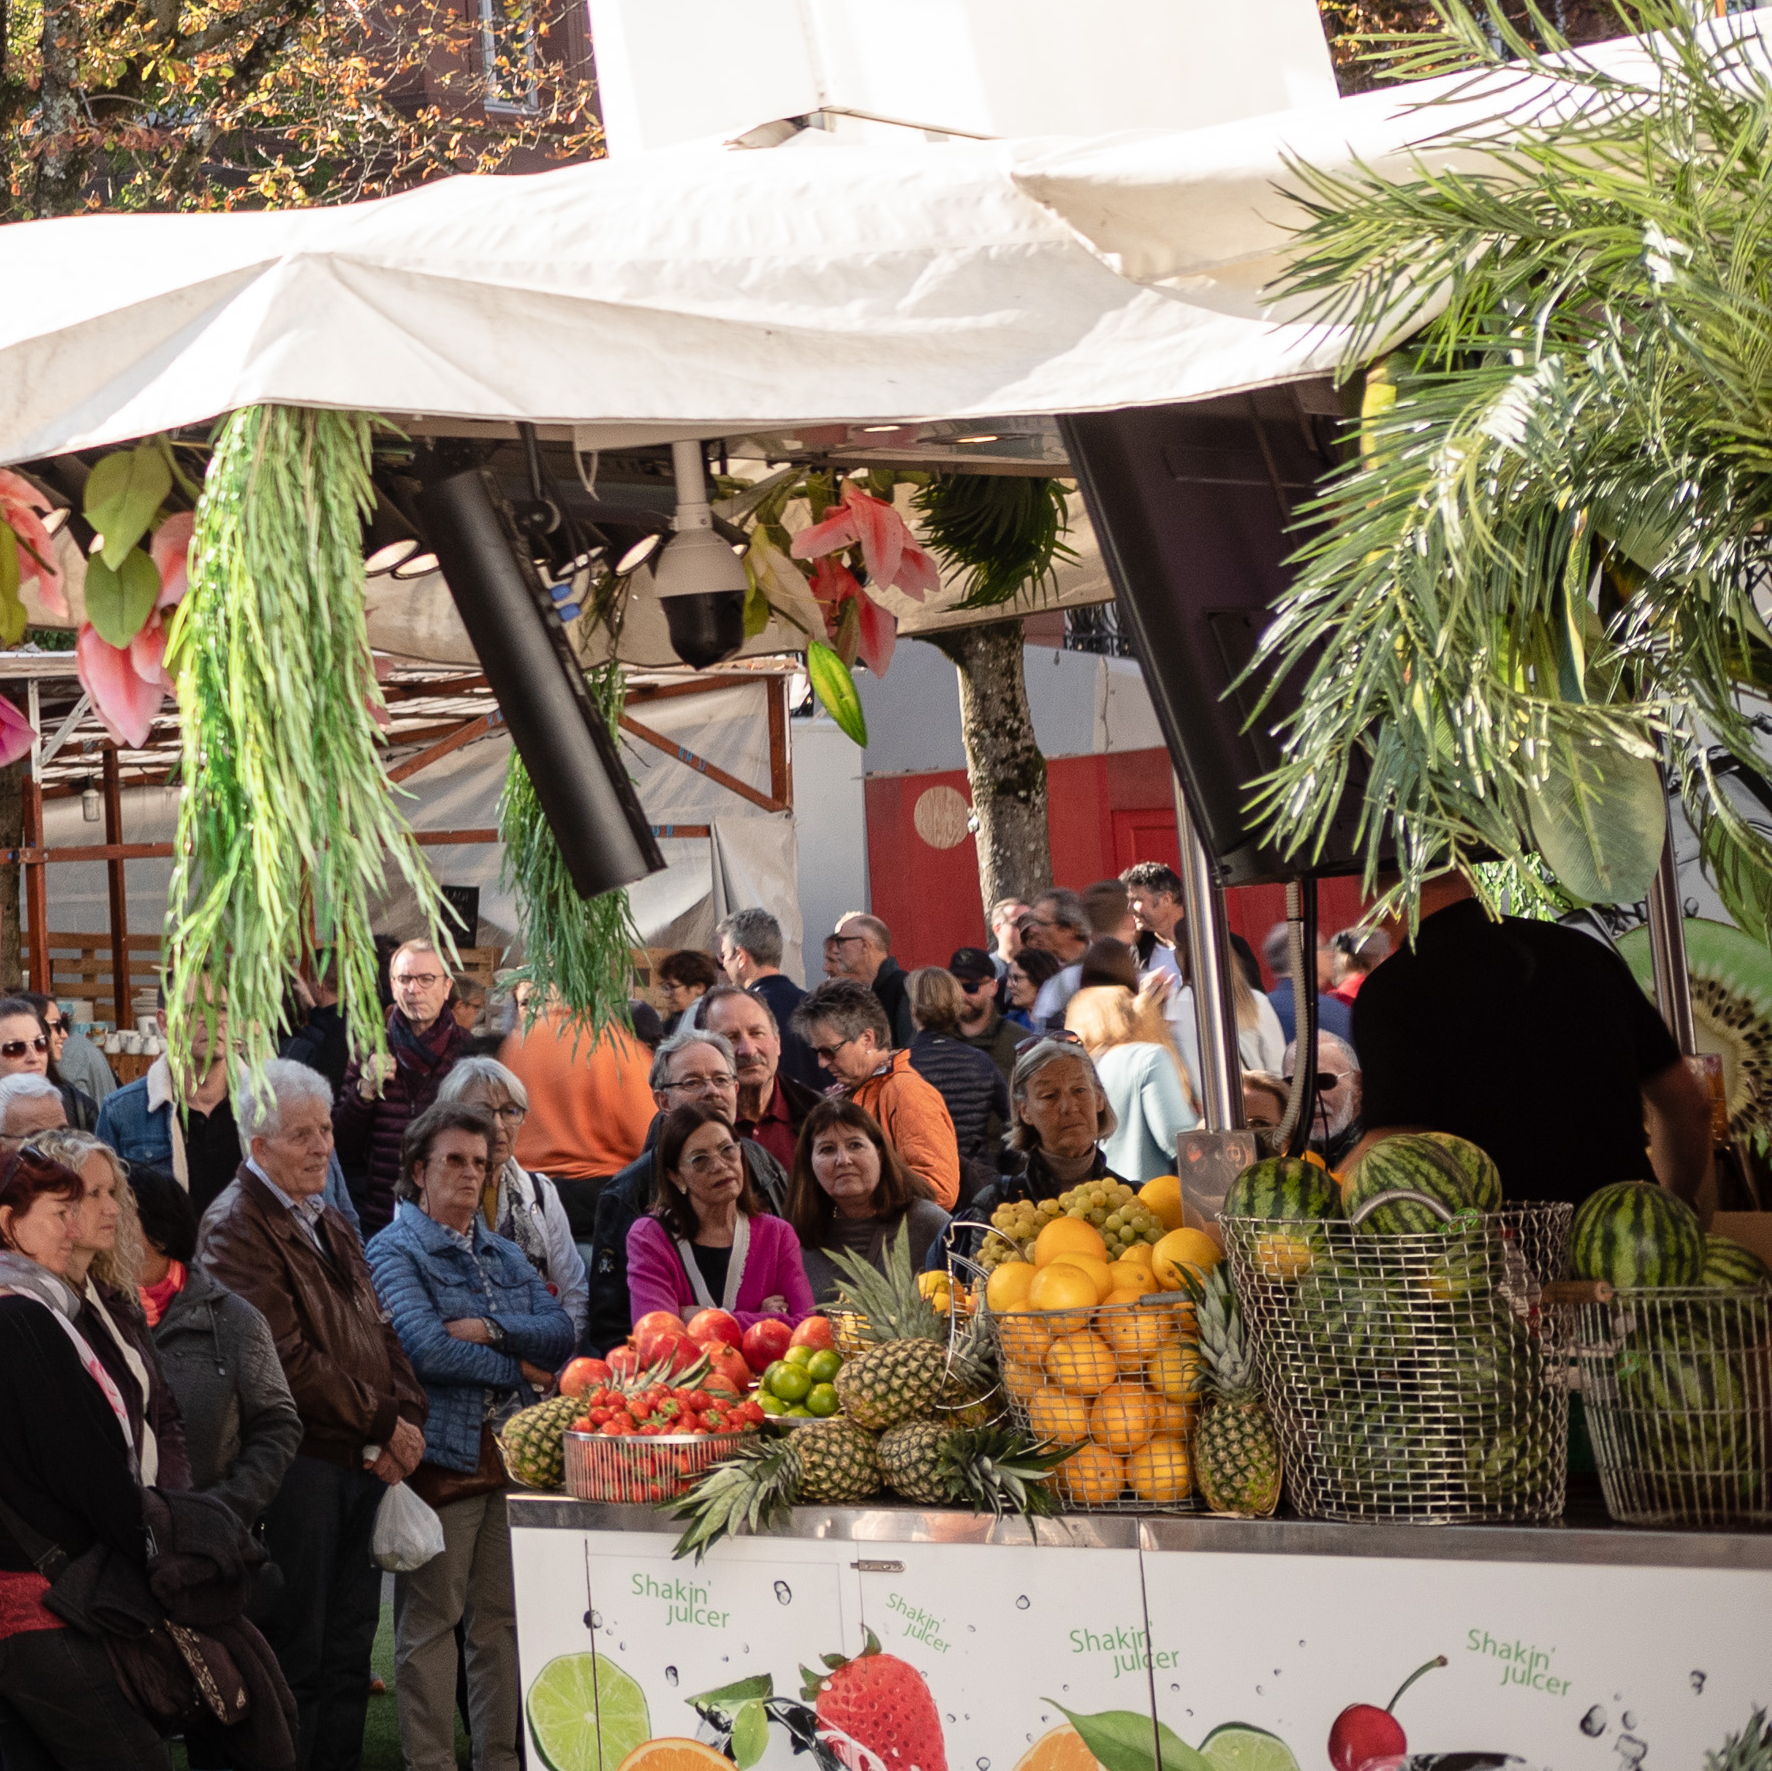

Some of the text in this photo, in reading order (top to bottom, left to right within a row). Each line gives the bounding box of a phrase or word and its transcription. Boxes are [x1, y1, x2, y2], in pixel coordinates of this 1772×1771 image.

[630, 1573, 712, 1605] Shakin'
[885, 1592, 947, 1633] Shakin'
[1466, 1628, 1557, 1671] Shakin'
